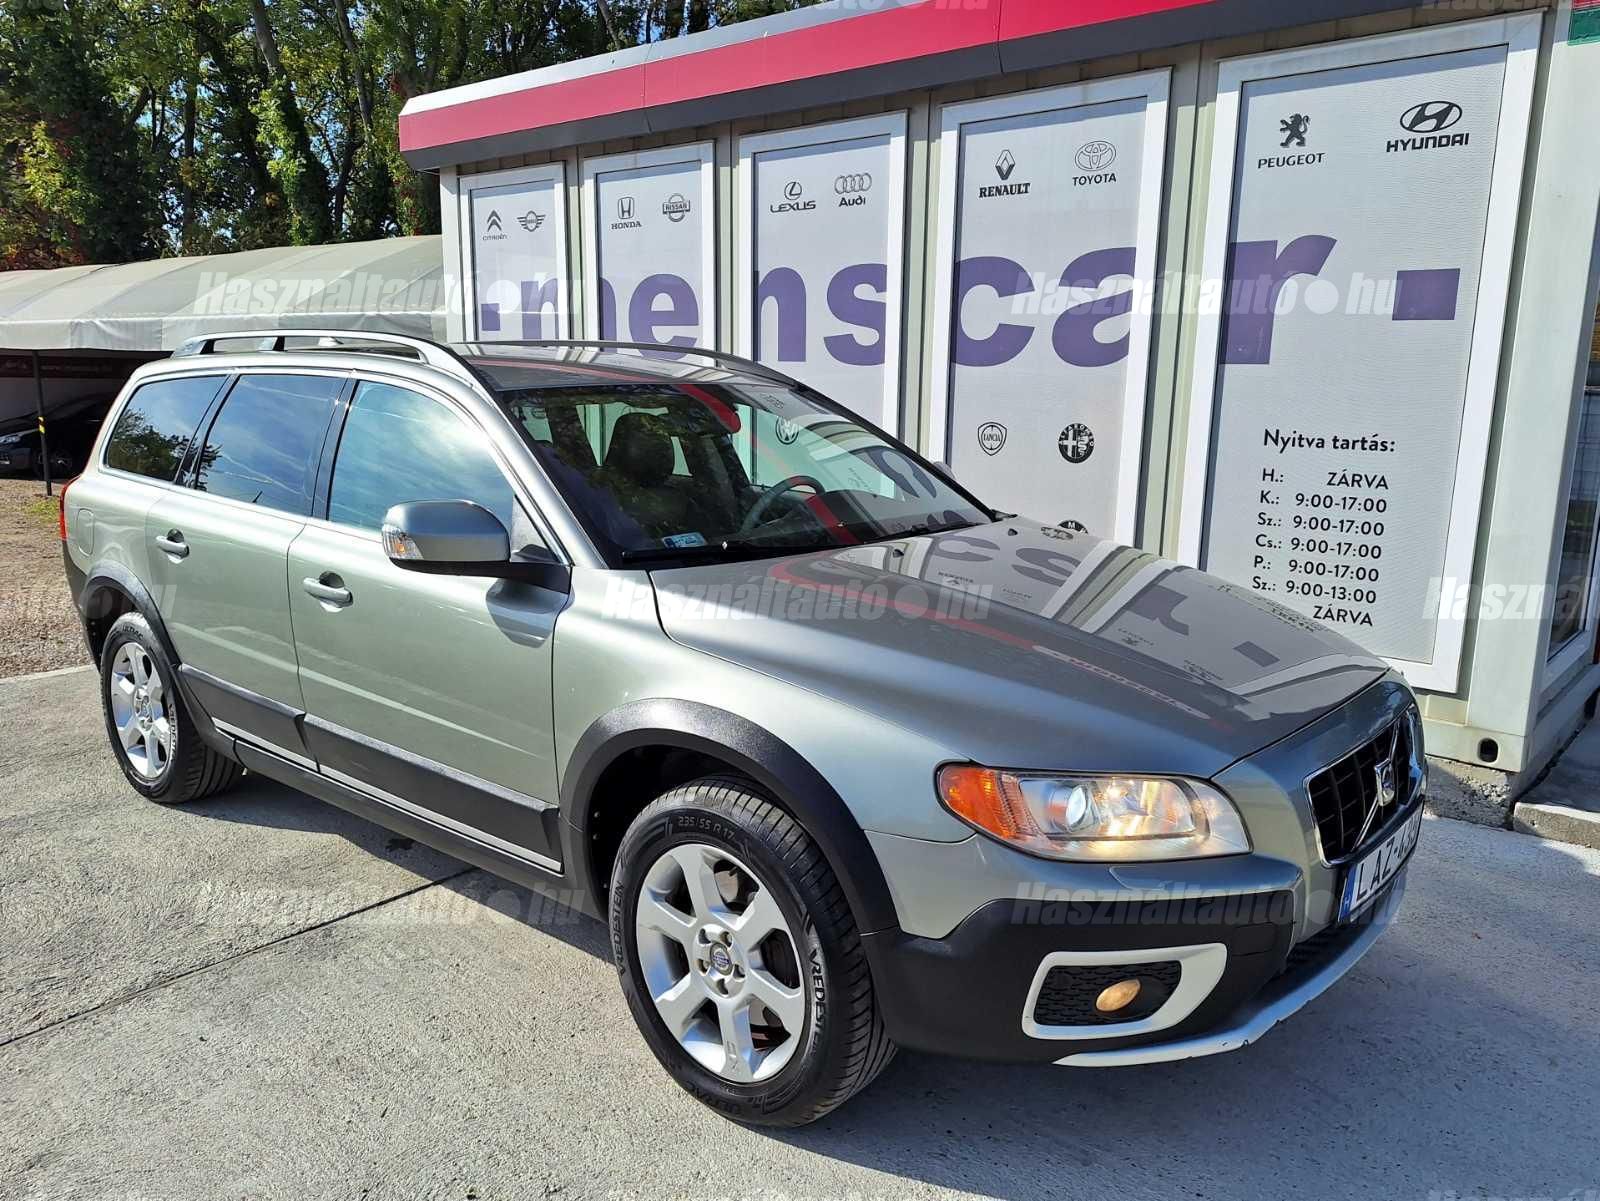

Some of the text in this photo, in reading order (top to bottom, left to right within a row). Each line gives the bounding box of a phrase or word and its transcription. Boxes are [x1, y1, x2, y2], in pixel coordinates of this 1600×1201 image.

[1386, 133, 1470, 153] HYUNDAI
[1257, 152, 1325, 169] PEUGEOT
[1072, 173, 1117, 186] TOYOTA
[979, 183, 1031, 198] RENAULT
[665, 202, 688, 211] NISSAN
[770, 200, 817, 213] LEXUS
[838, 195, 866, 208] Audi
[611, 221, 642, 230] HONDA
[1263, 429, 1396, 454] Nyitva tartás:
[1262, 468, 1389, 490] H.: ZÁRVA
[1259, 490, 1387, 513] K.: 9:00-17:00
[1257, 512, 1385, 536] Sz.: 9:00-17:00
[1255, 533, 1382, 559] Cs.: 9:00-17:00
[1253, 555, 1379, 582] P.: 9:00-17:00
[1252, 576, 1377, 604] Sz.: 9:00-13:00
[1313, 603, 1373, 627] ZÁRVA
